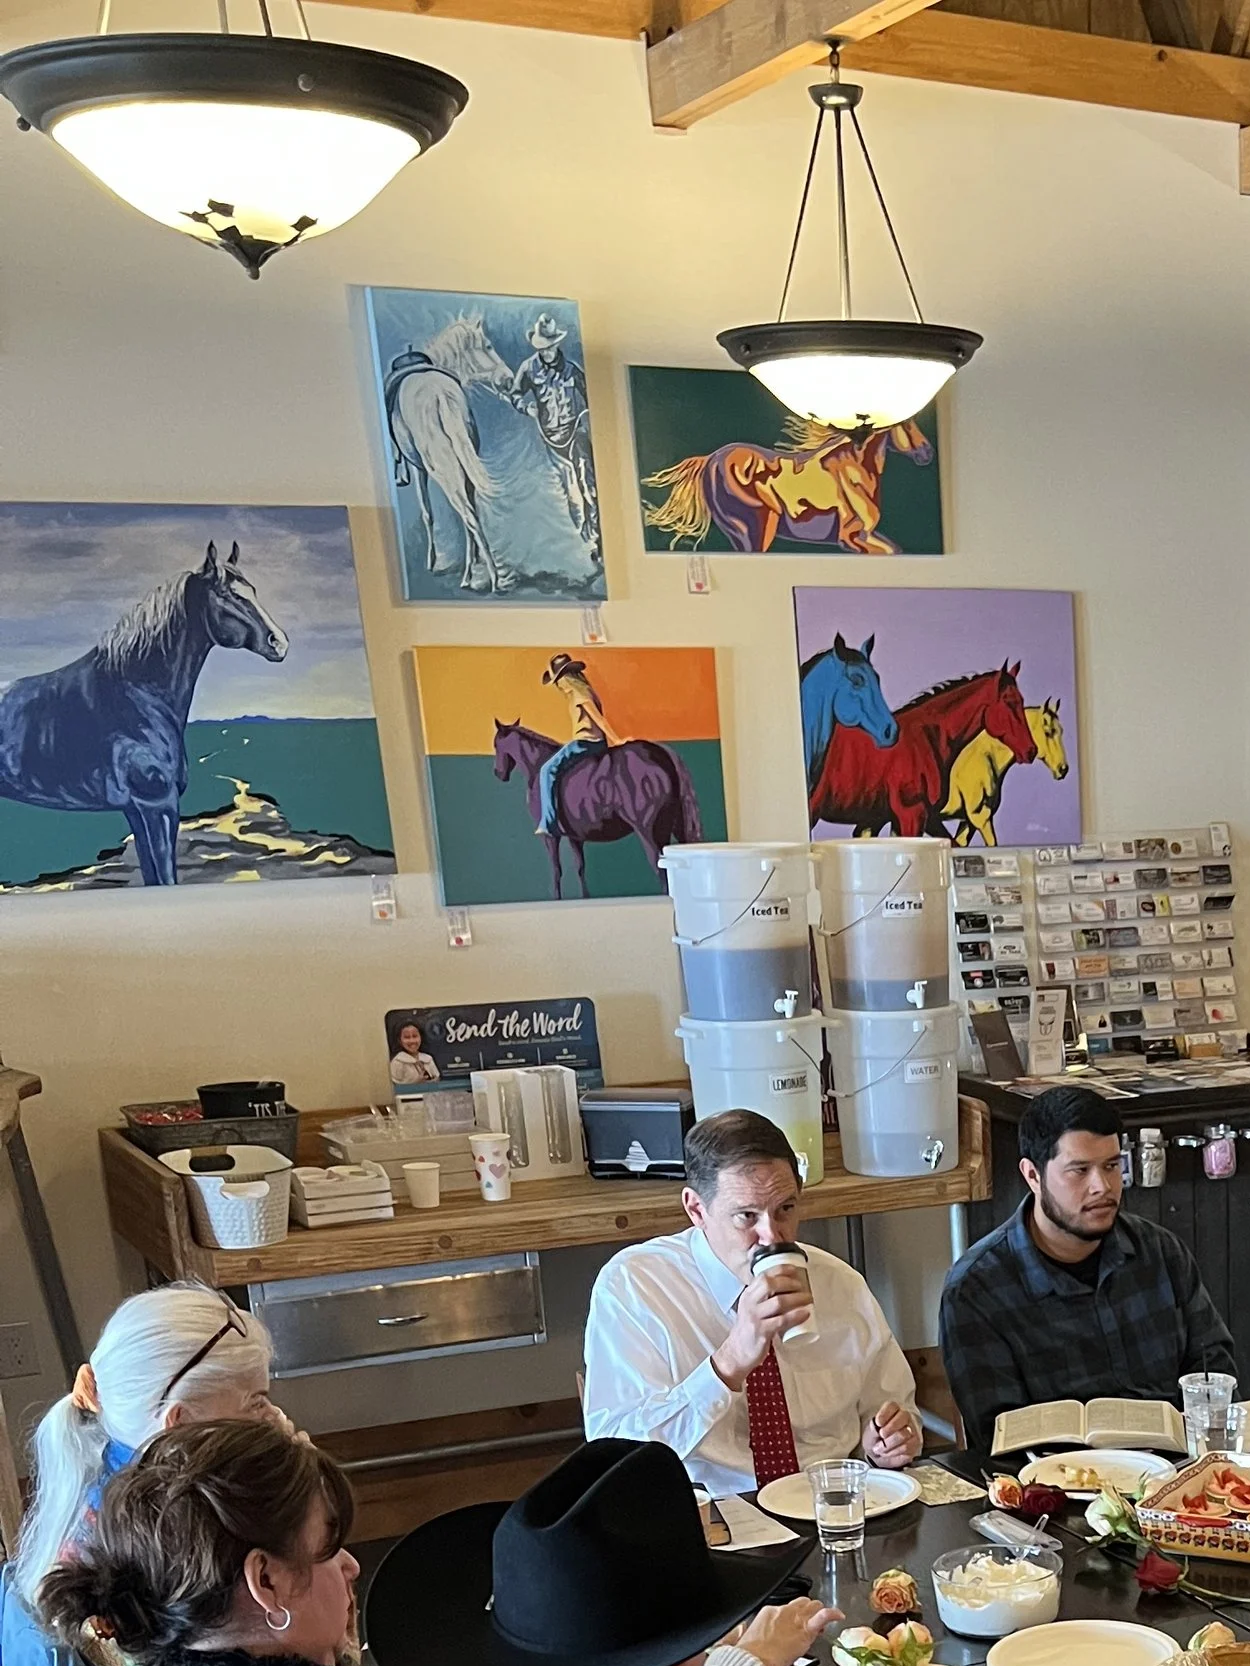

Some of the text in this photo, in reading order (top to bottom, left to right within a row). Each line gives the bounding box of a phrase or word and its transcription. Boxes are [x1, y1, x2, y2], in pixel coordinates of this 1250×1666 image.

[885, 900, 923, 910] Iced Tea
[752, 906, 788, 916] Iced Tea
[445, 1003, 583, 1043] Send the Word
[910, 1065, 939, 1076] WATER
[772, 1075, 808, 1091] LEMONADE
